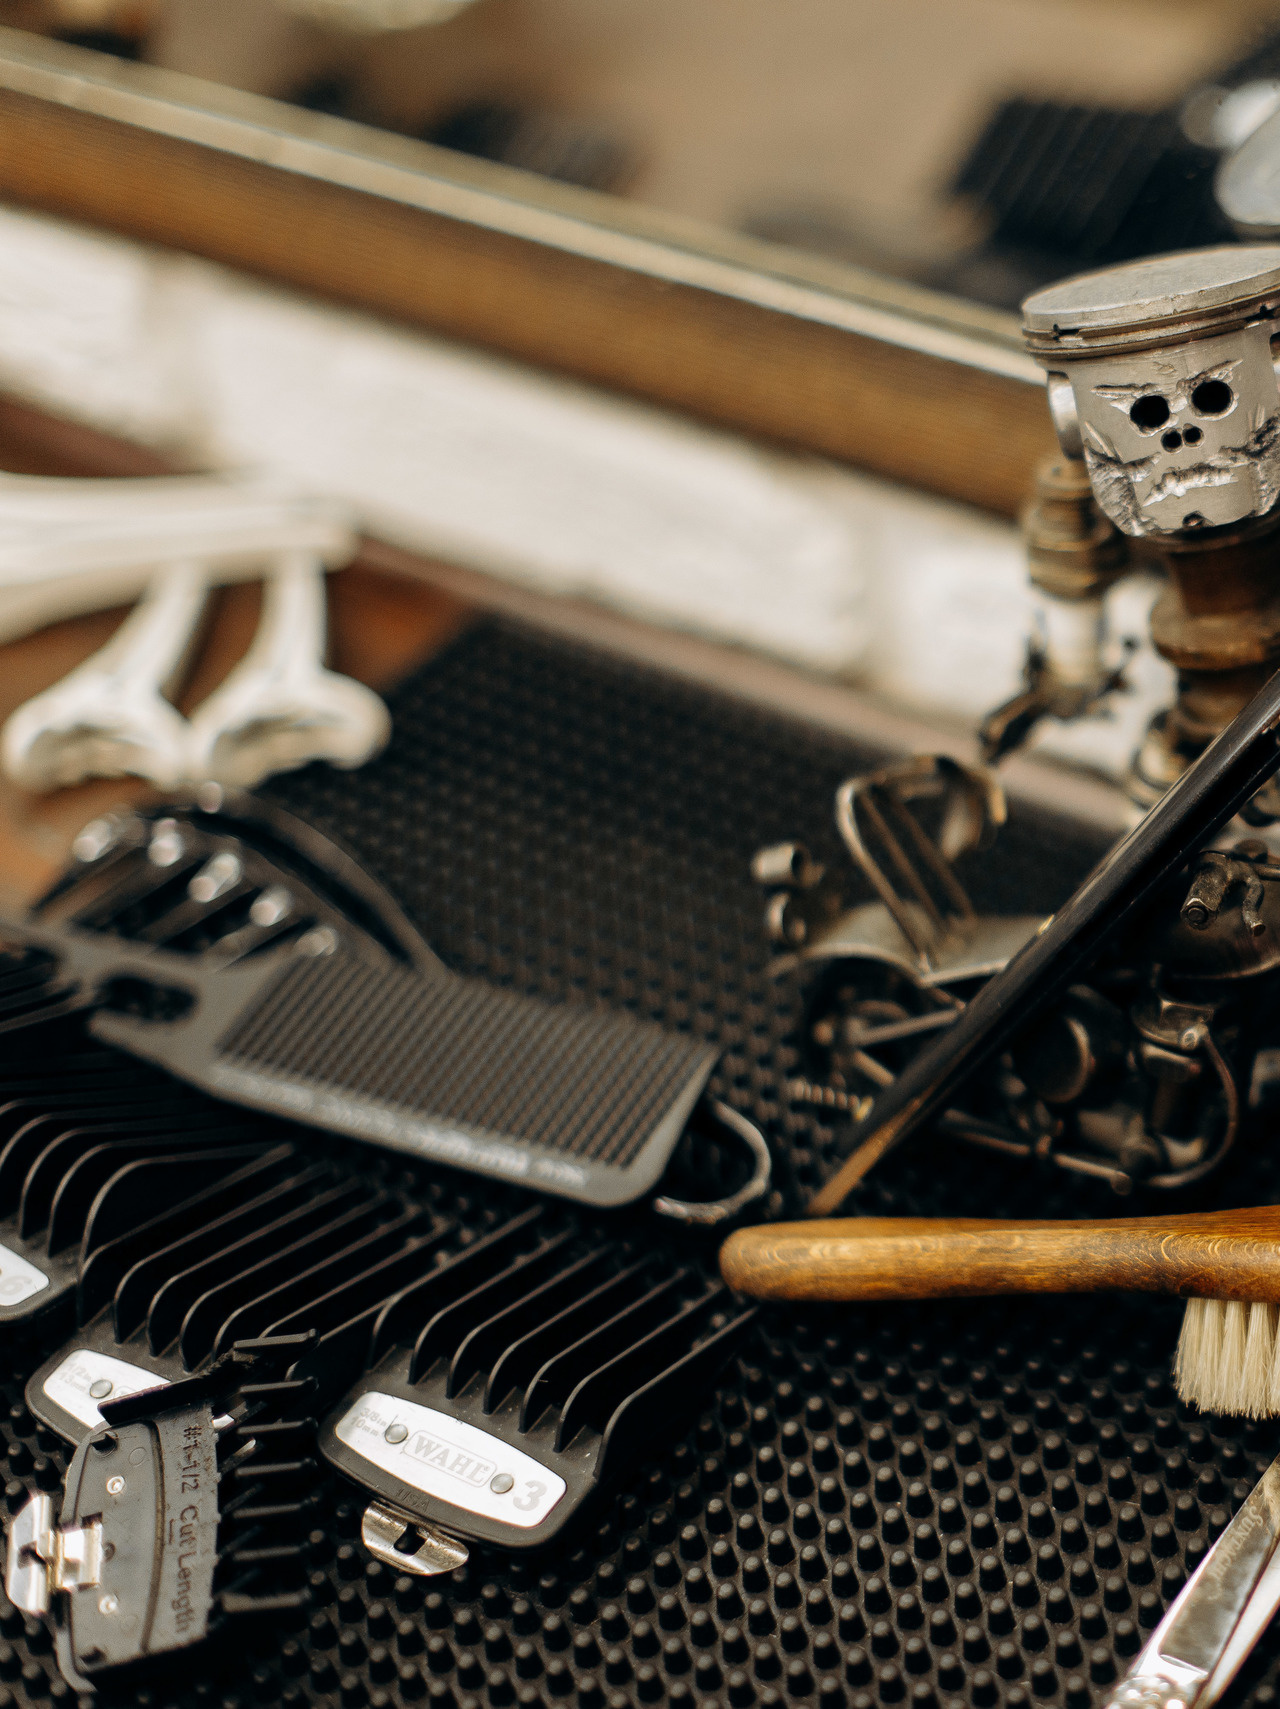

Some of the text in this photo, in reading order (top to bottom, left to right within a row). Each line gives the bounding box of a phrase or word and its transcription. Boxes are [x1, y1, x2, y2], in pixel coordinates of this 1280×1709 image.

[512, 1479, 548, 1512] 3
[179, 1504, 199, 1548] Cut
[170, 1551, 197, 1634] Length
